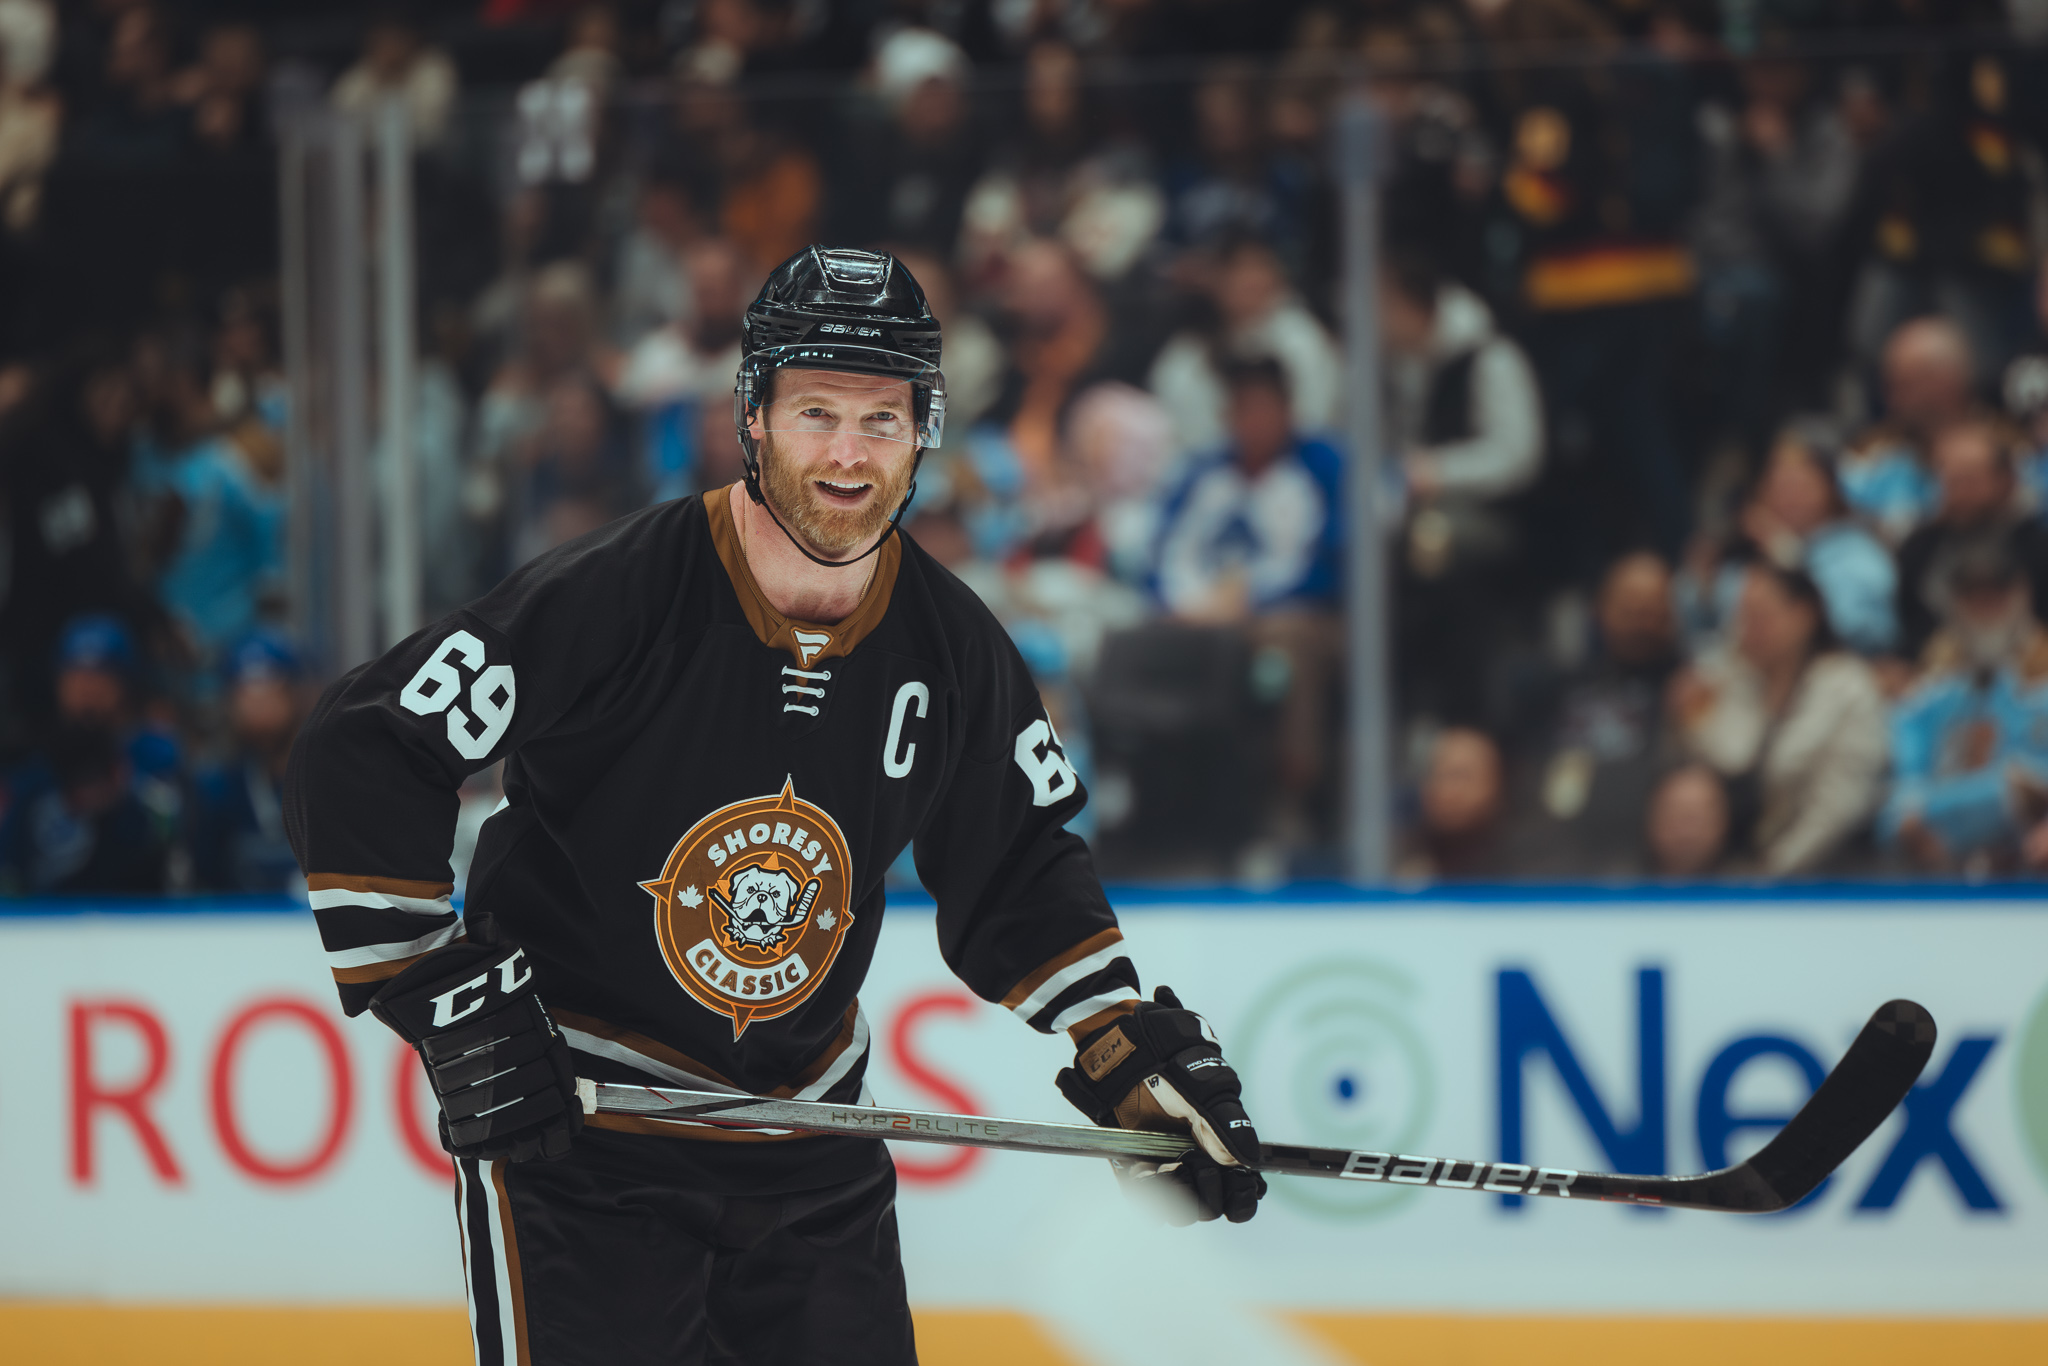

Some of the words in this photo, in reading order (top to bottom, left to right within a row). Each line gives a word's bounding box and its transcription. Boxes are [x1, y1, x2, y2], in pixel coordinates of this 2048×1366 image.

[399, 629, 516, 760] 69
[883, 681, 930, 778] C
[1014, 706, 1077, 807] 6
[707, 822, 832, 876] SHORESY
[695, 948, 801, 995] CLASSIC
[1090, 1037, 1122, 1073] CCM
[832, 1101, 999, 1136] HYP2RLITE
[1339, 1150, 1579, 1197] BAUER
